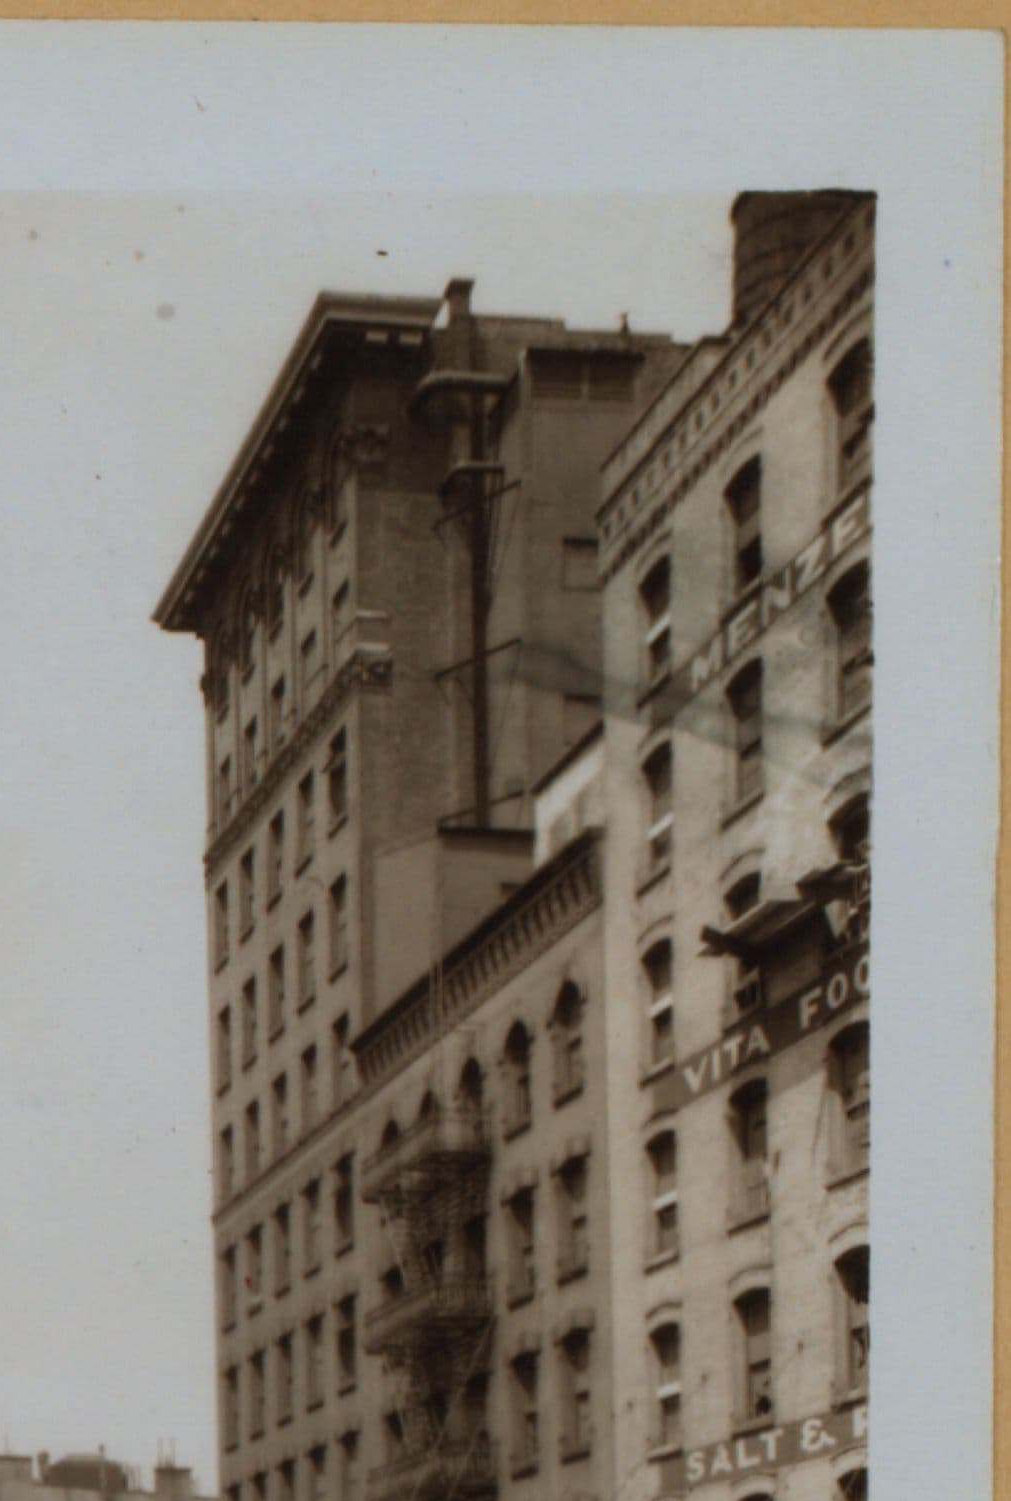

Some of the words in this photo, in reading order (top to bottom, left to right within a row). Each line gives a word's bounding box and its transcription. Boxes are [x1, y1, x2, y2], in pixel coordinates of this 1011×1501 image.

[690, 495, 865, 693] MENZE
[683, 1023, 771, 1094] VITA
[685, 1426, 785, 1482] SALT
[800, 1417, 837, 1452] &
